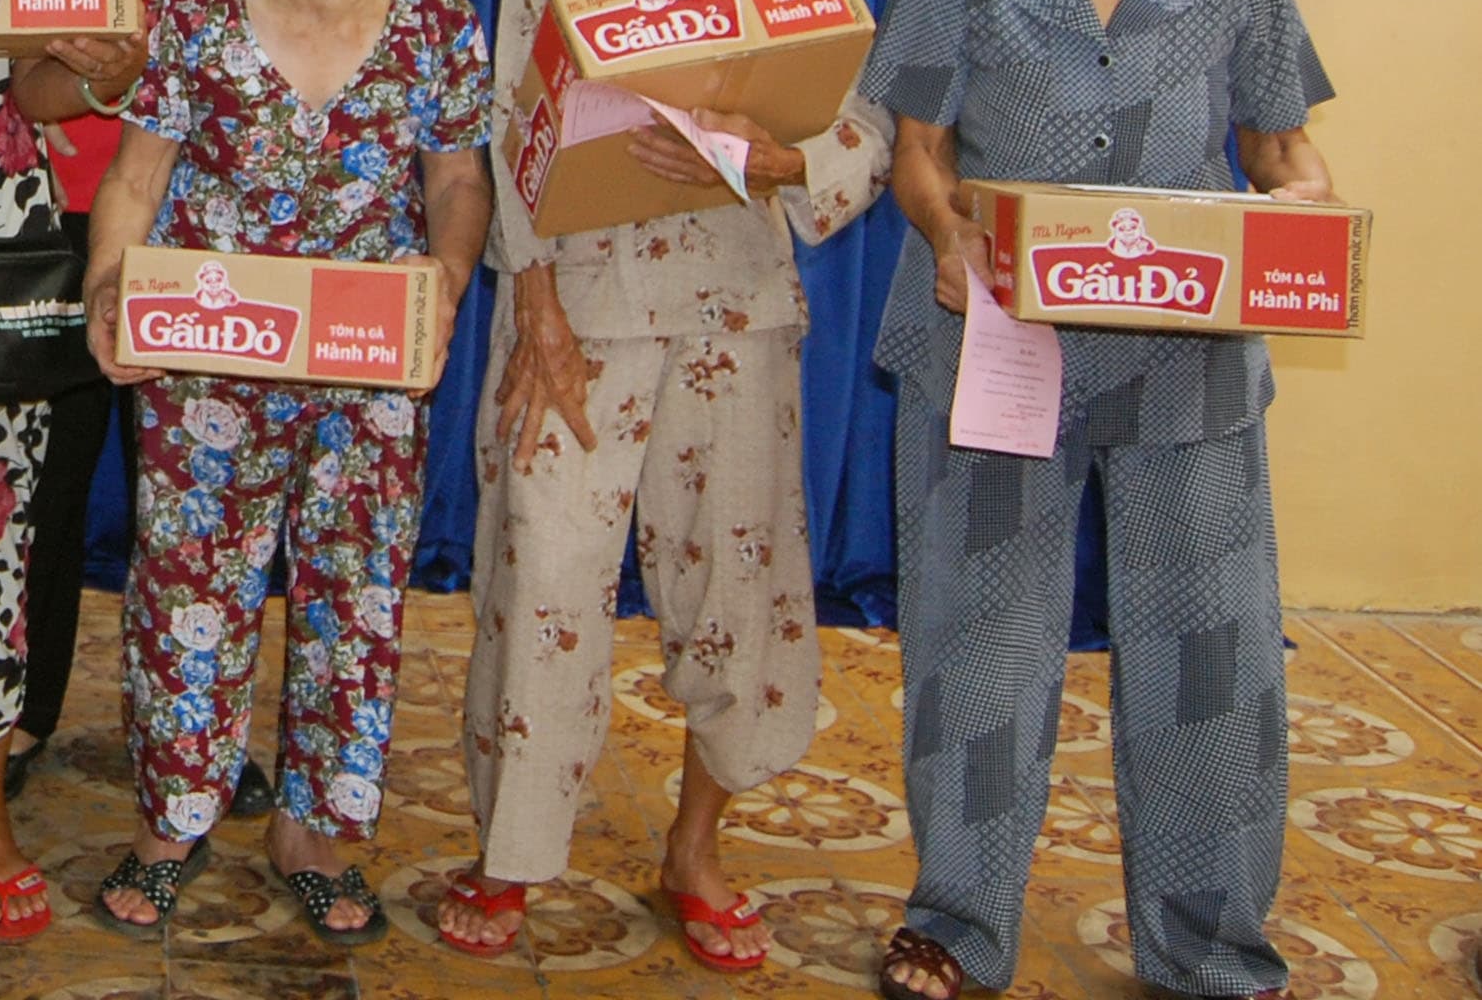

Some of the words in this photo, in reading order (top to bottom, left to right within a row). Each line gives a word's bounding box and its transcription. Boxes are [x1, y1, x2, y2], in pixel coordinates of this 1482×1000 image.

[765, 4, 812, 25] Hành
[1055, 223, 1092, 240] Ngon
[1348, 263, 1363, 293] ngon
[1249, 288, 1302, 310] Hành
[1306, 291, 1340, 312] Phi
[315, 343, 363, 362] Hành
[367, 346, 397, 364] Phi
